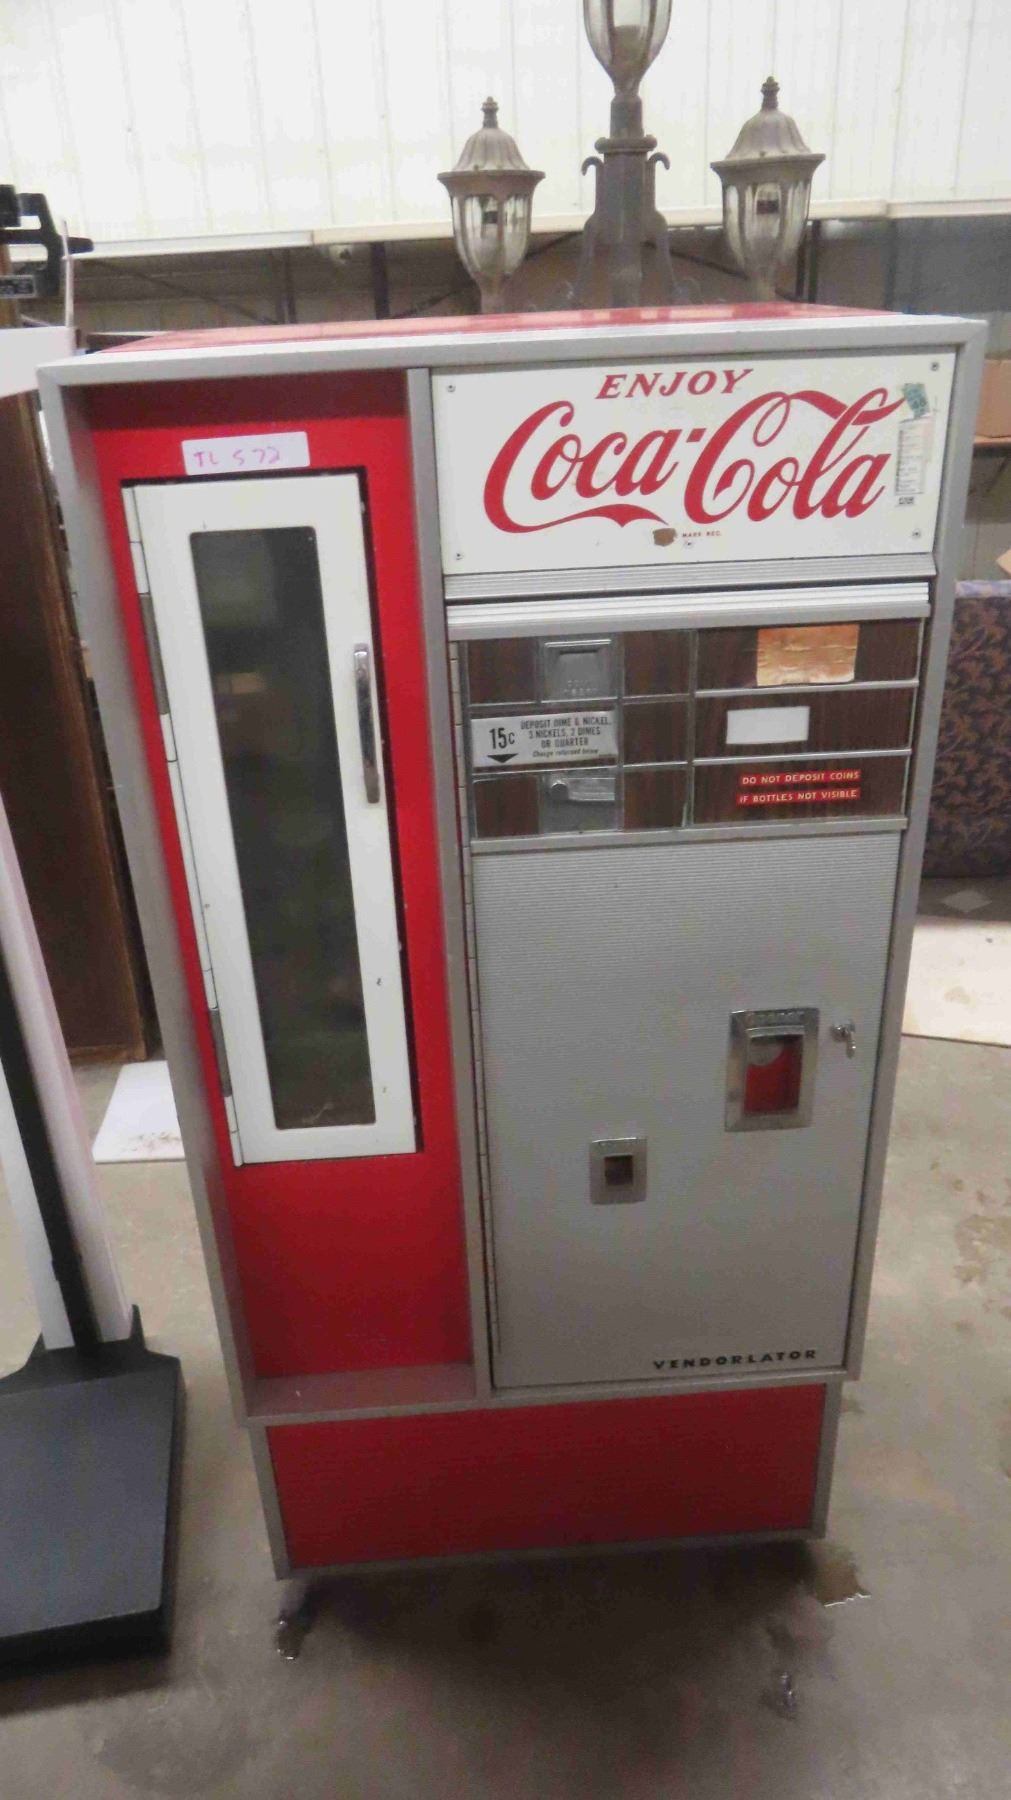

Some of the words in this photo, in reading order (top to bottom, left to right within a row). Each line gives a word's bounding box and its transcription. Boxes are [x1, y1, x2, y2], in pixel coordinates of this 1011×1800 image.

[595, 367, 754, 400] ENJOY
[193, 450, 219, 468] TL
[483, 387, 907, 533] Coca-Cola
[520, 718, 551, 730] DEPOSIT
[553, 717, 572, 728] DIME
[577, 726, 601, 736] DIMES
[541, 739, 552, 749] OR
[554, 737, 589, 748] QUARTER
[742, 776, 757, 785] DO
[760, 775, 781, 784] NOT
[784, 772, 825, 783] DEPOSIT
[829, 770, 859, 780] COINS
[739, 795, 749, 804] IF
[753, 793, 793, 803] BOTTLES
[797, 791, 817, 801] NOT
[820, 789, 858, 799] VISIBLE
[653, 1349, 817, 1370] VENDORLATOR
